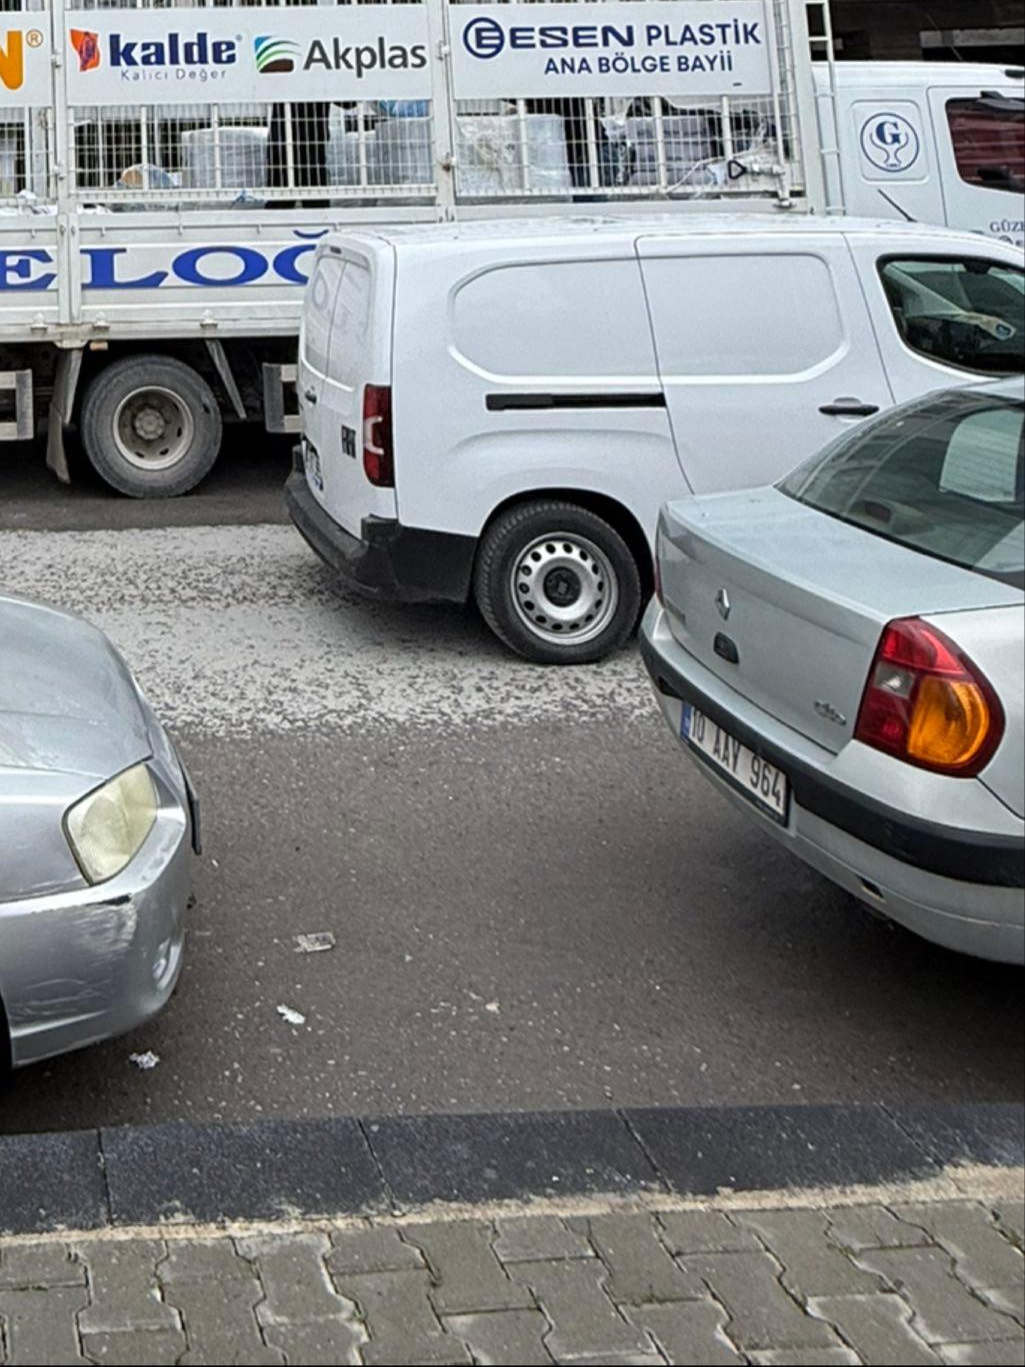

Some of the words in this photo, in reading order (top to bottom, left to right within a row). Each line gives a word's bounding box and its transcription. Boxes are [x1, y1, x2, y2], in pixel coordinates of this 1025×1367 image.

[510, 25, 635, 49] ESEN
[647, 18, 762, 46] PLASTİK
[109, 32, 237, 67] kalde
[302, 36, 427, 78] Akplas
[544, 56, 592, 75] ANA
[598, 51, 671, 74] BÖLGE
[175, 68, 227, 83] Değer
[989, 219, 1024, 233] GÜZ
[750, 754, 782, 808] 964
